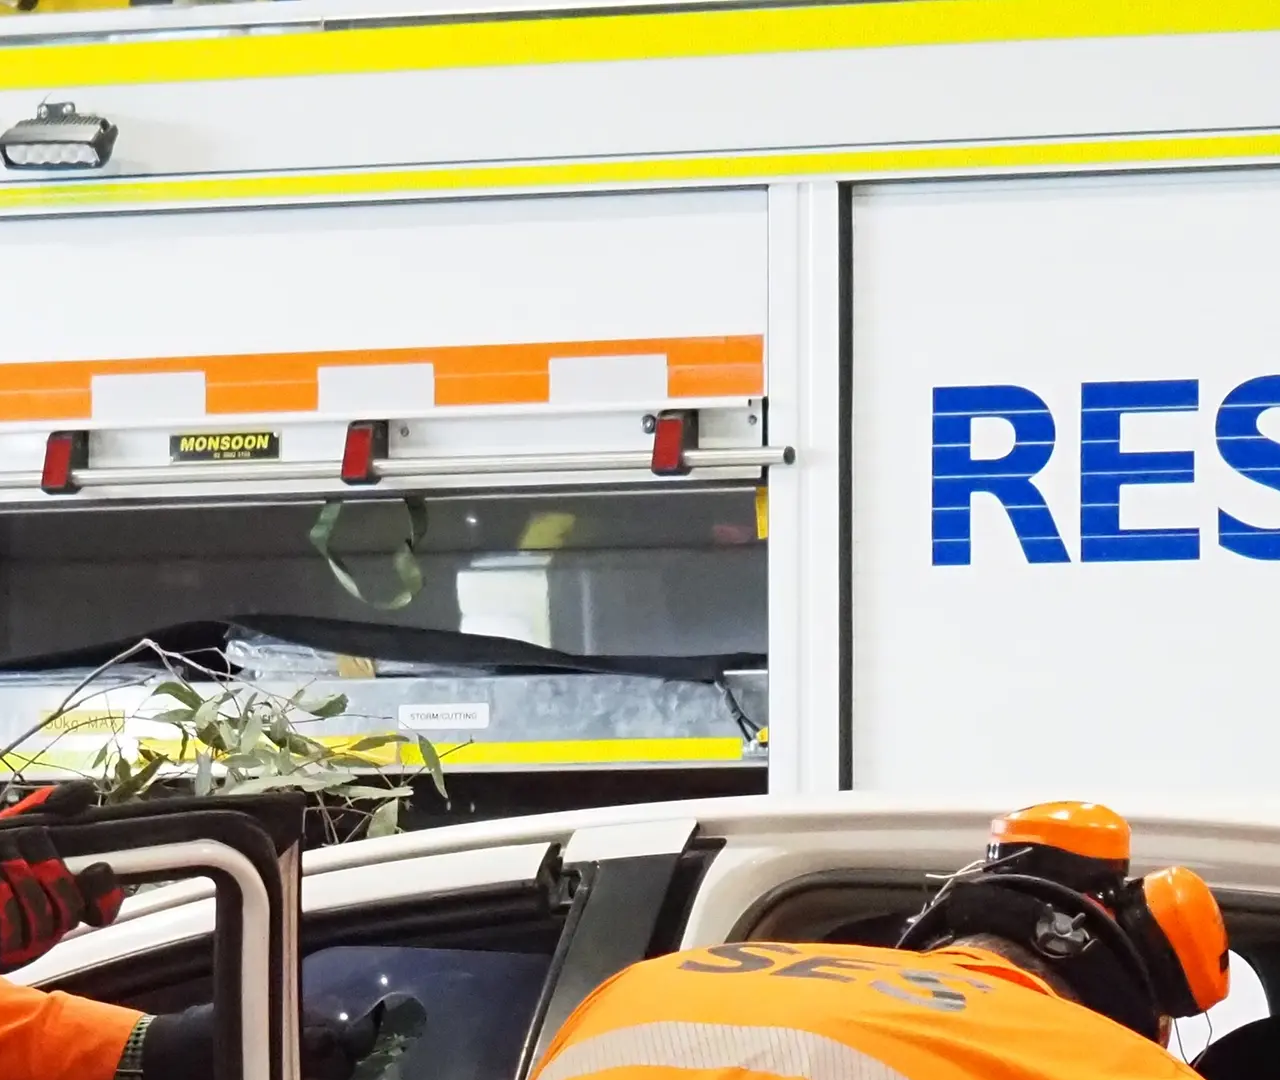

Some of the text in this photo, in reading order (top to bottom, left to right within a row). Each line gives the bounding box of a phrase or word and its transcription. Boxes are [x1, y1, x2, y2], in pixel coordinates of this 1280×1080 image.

[180, 434, 270, 452] MONSOON
[88, 718, 118, 729] MAX
[677, 942, 996, 1012] SES
